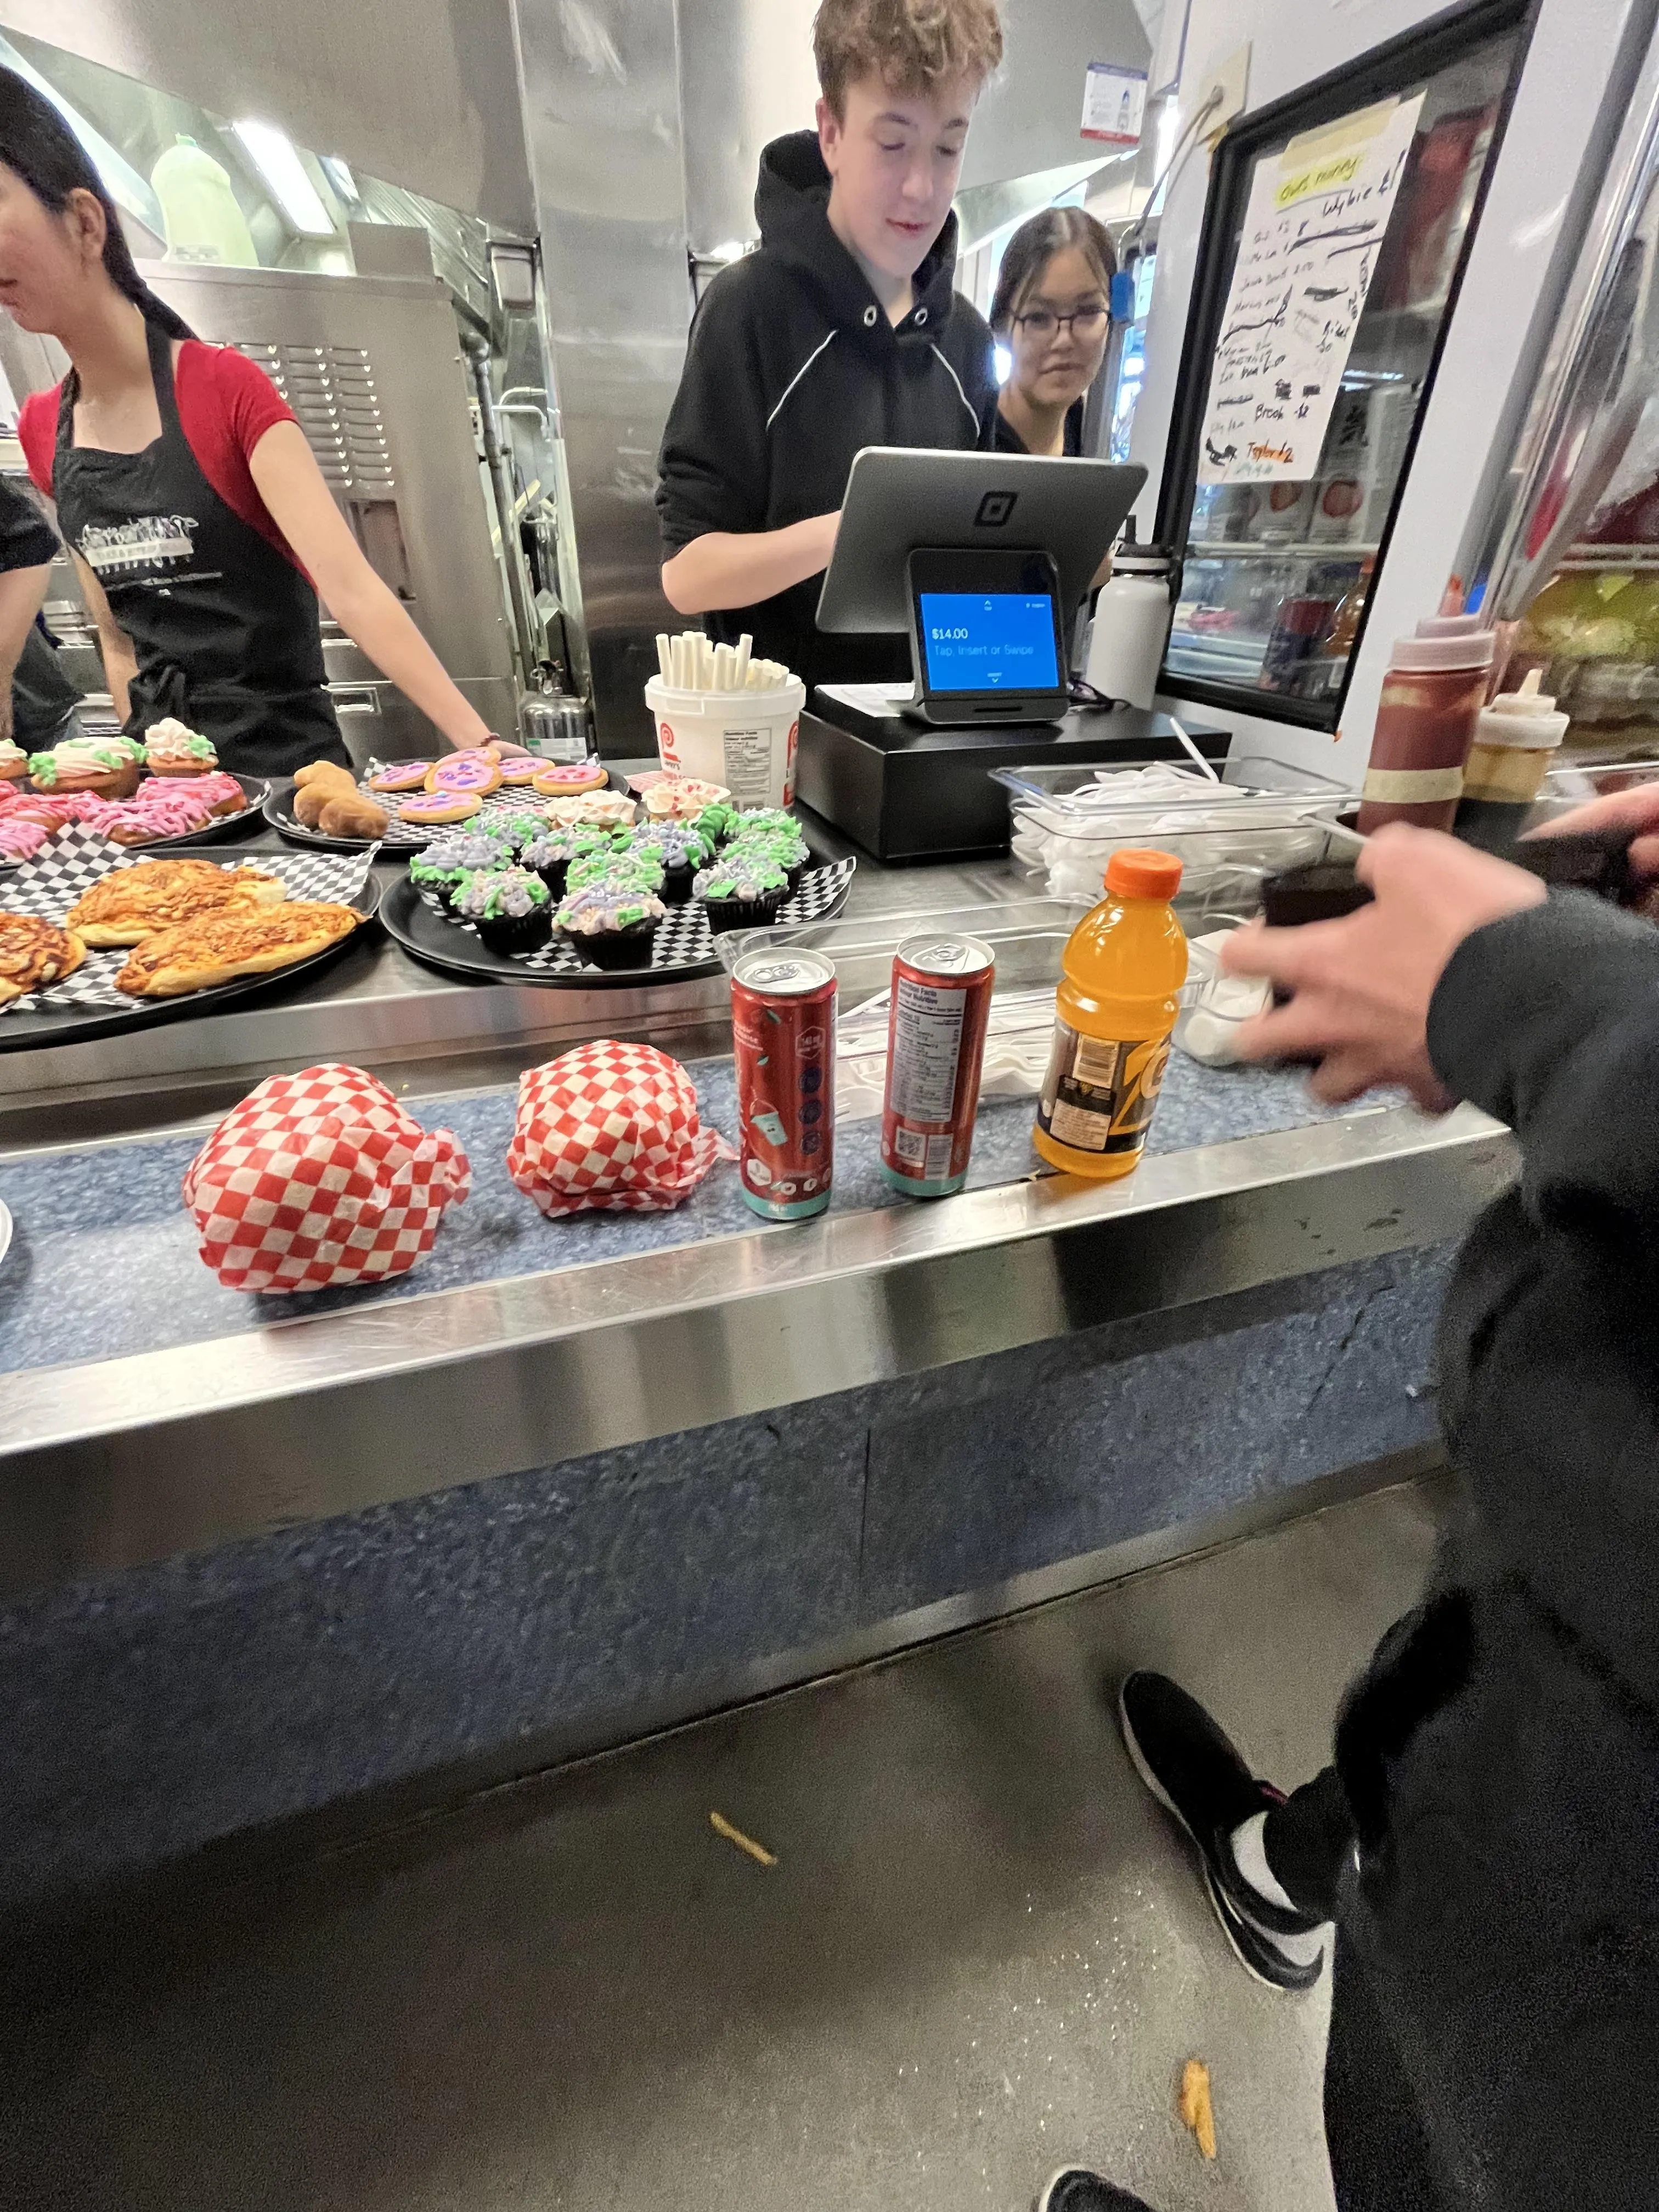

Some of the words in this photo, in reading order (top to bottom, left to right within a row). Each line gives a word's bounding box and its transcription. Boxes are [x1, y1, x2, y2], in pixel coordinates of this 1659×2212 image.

[932, 628, 968, 640] $14.00
[958, 645, 988, 656] Insert
[991, 647, 1001, 655] or
[1005, 644, 1034, 656] Swipe
